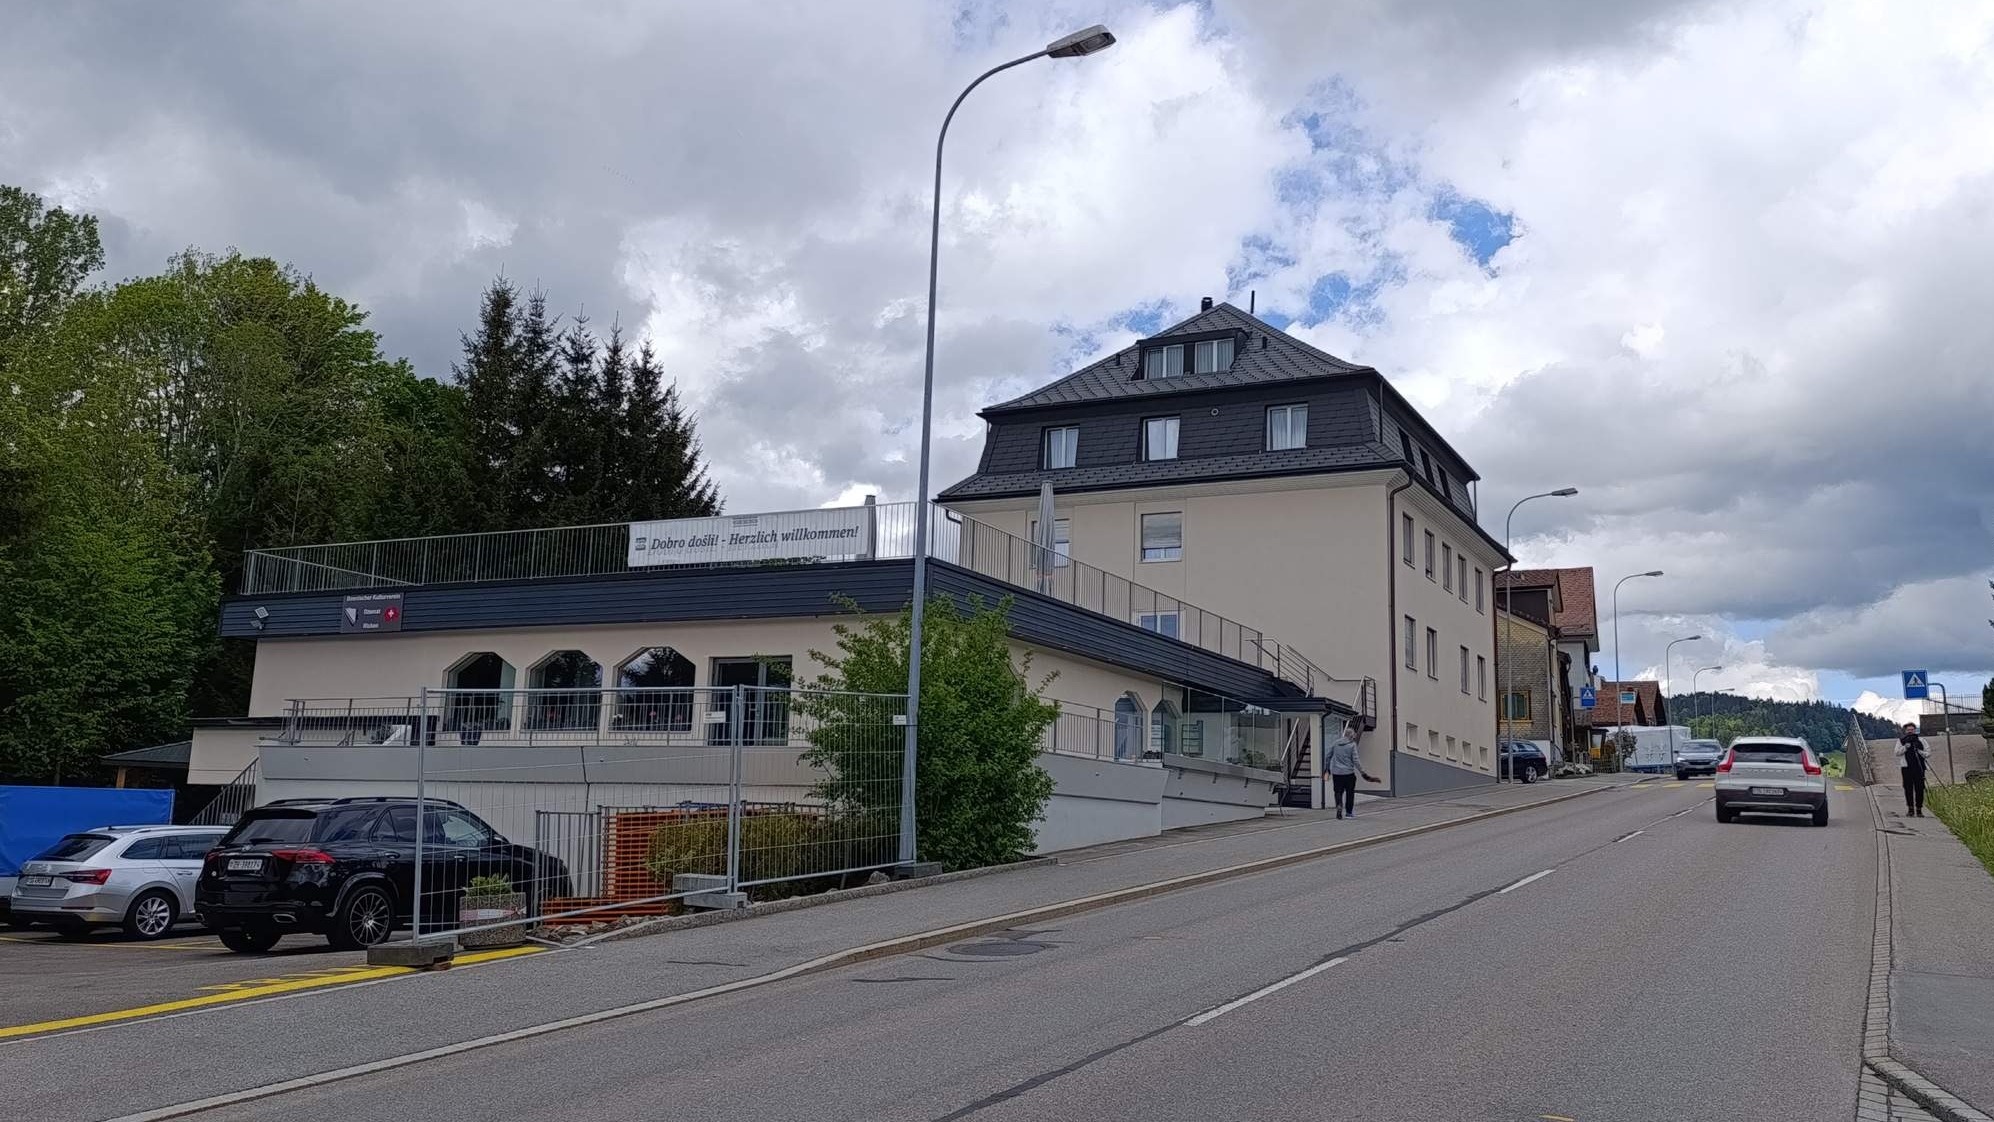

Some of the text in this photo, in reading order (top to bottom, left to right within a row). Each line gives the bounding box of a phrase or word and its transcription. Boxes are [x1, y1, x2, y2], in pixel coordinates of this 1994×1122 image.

[651, 537, 685, 550] Dobro
[729, 530, 777, 545] Herzlich
[781, 526, 859, 542] willkommen!
